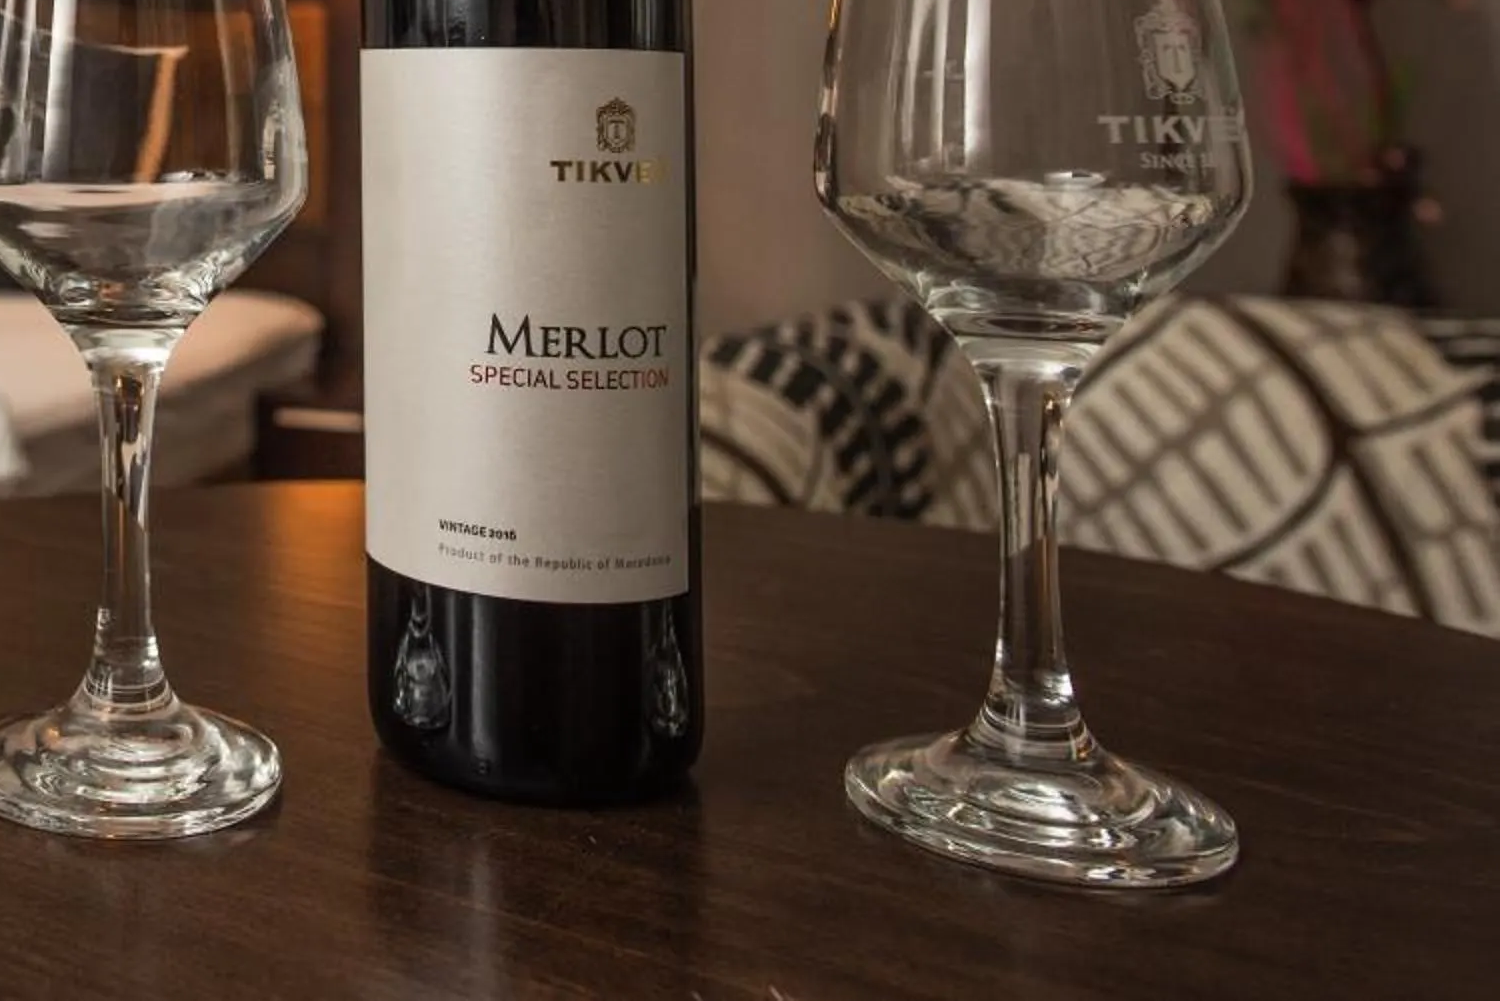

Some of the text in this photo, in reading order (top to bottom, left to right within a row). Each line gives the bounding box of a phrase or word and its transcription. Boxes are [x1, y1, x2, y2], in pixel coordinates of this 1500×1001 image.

[550, 159, 668, 183] TIKVE
[469, 364, 670, 390] SPECIAL SELECTION
[438, 518, 487, 539] VINTAGE
[437, 542, 484, 563] Product
[489, 552, 503, 565] of
[507, 551, 530, 568] the
[535, 552, 593, 572] Republic
[597, 553, 610, 570] of
